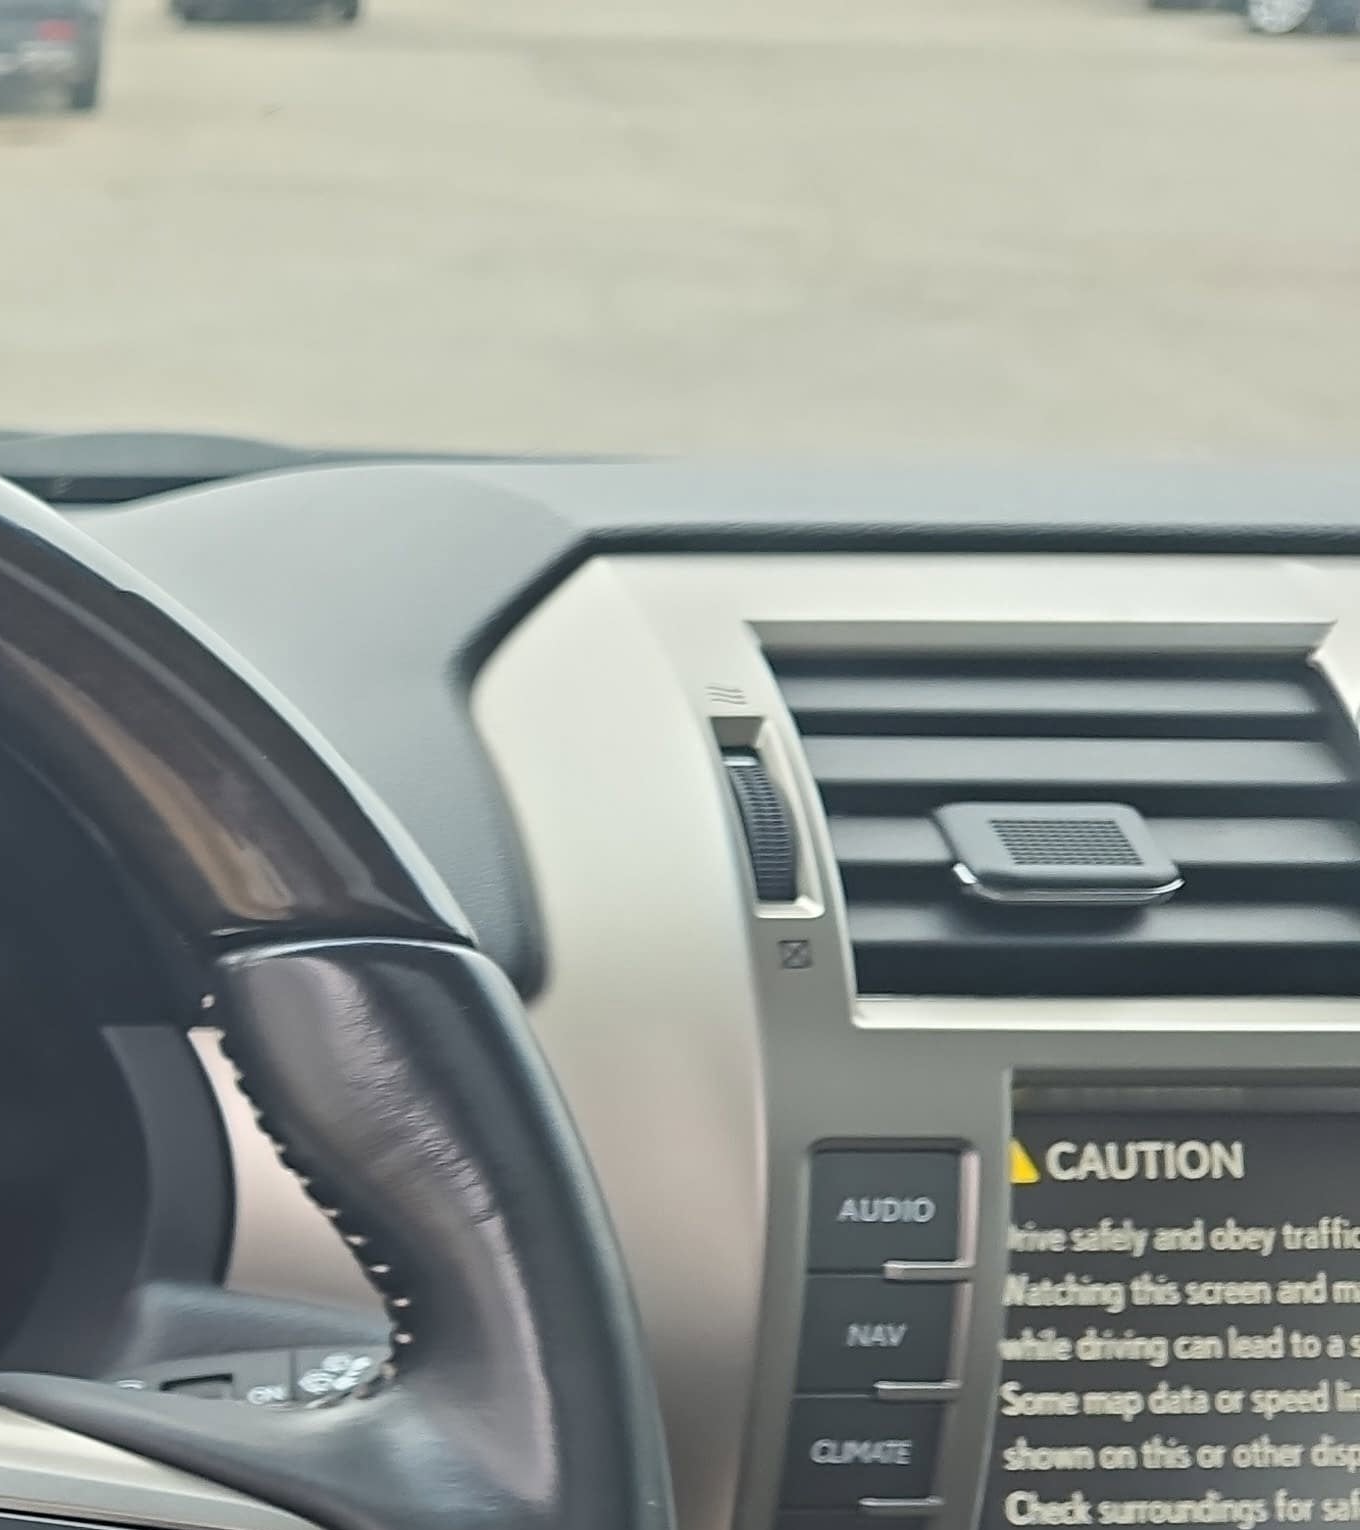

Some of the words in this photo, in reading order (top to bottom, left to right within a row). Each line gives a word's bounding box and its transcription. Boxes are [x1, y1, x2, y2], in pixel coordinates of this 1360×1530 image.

[1045, 1141, 1245, 1180] CAUTION
[836, 1197, 936, 1223] AUDIO
[1070, 1217, 1148, 1257] safely
[1152, 1217, 1204, 1251] and
[1209, 1217, 1276, 1257] obey
[1130, 1271, 1180, 1305] this
[1185, 1281, 1271, 1305] screen
[1277, 1270, 1327, 1305] and
[845, 1322, 909, 1347] NAV
[1076, 1326, 1169, 1367] driving
[1173, 1336, 1223, 1360] can
[1228, 1325, 1285, 1359] lead
[1289, 1330, 1322, 1359] to
[1326, 1334, 1346, 1359] a
[1000, 1380, 1079, 1416] Some
[1083, 1391, 1144, 1422] map
[1148, 1380, 1210, 1414] data
[1215, 1389, 1245, 1414] or
[1250, 1379, 1329, 1420] speed
[809, 1439, 912, 1465] CLIMATE
[1003, 1436, 1095, 1471] shown
[1098, 1445, 1137, 1469] on
[1141, 1434, 1192, 1469] this
[1196, 1445, 1226, 1469] or
[1232, 1434, 1304, 1469] other
[1005, 1490, 1093, 1526] Check
[1097, 1489, 1270, 1530] surroundings
[1275, 1488, 1314, 1522] for
